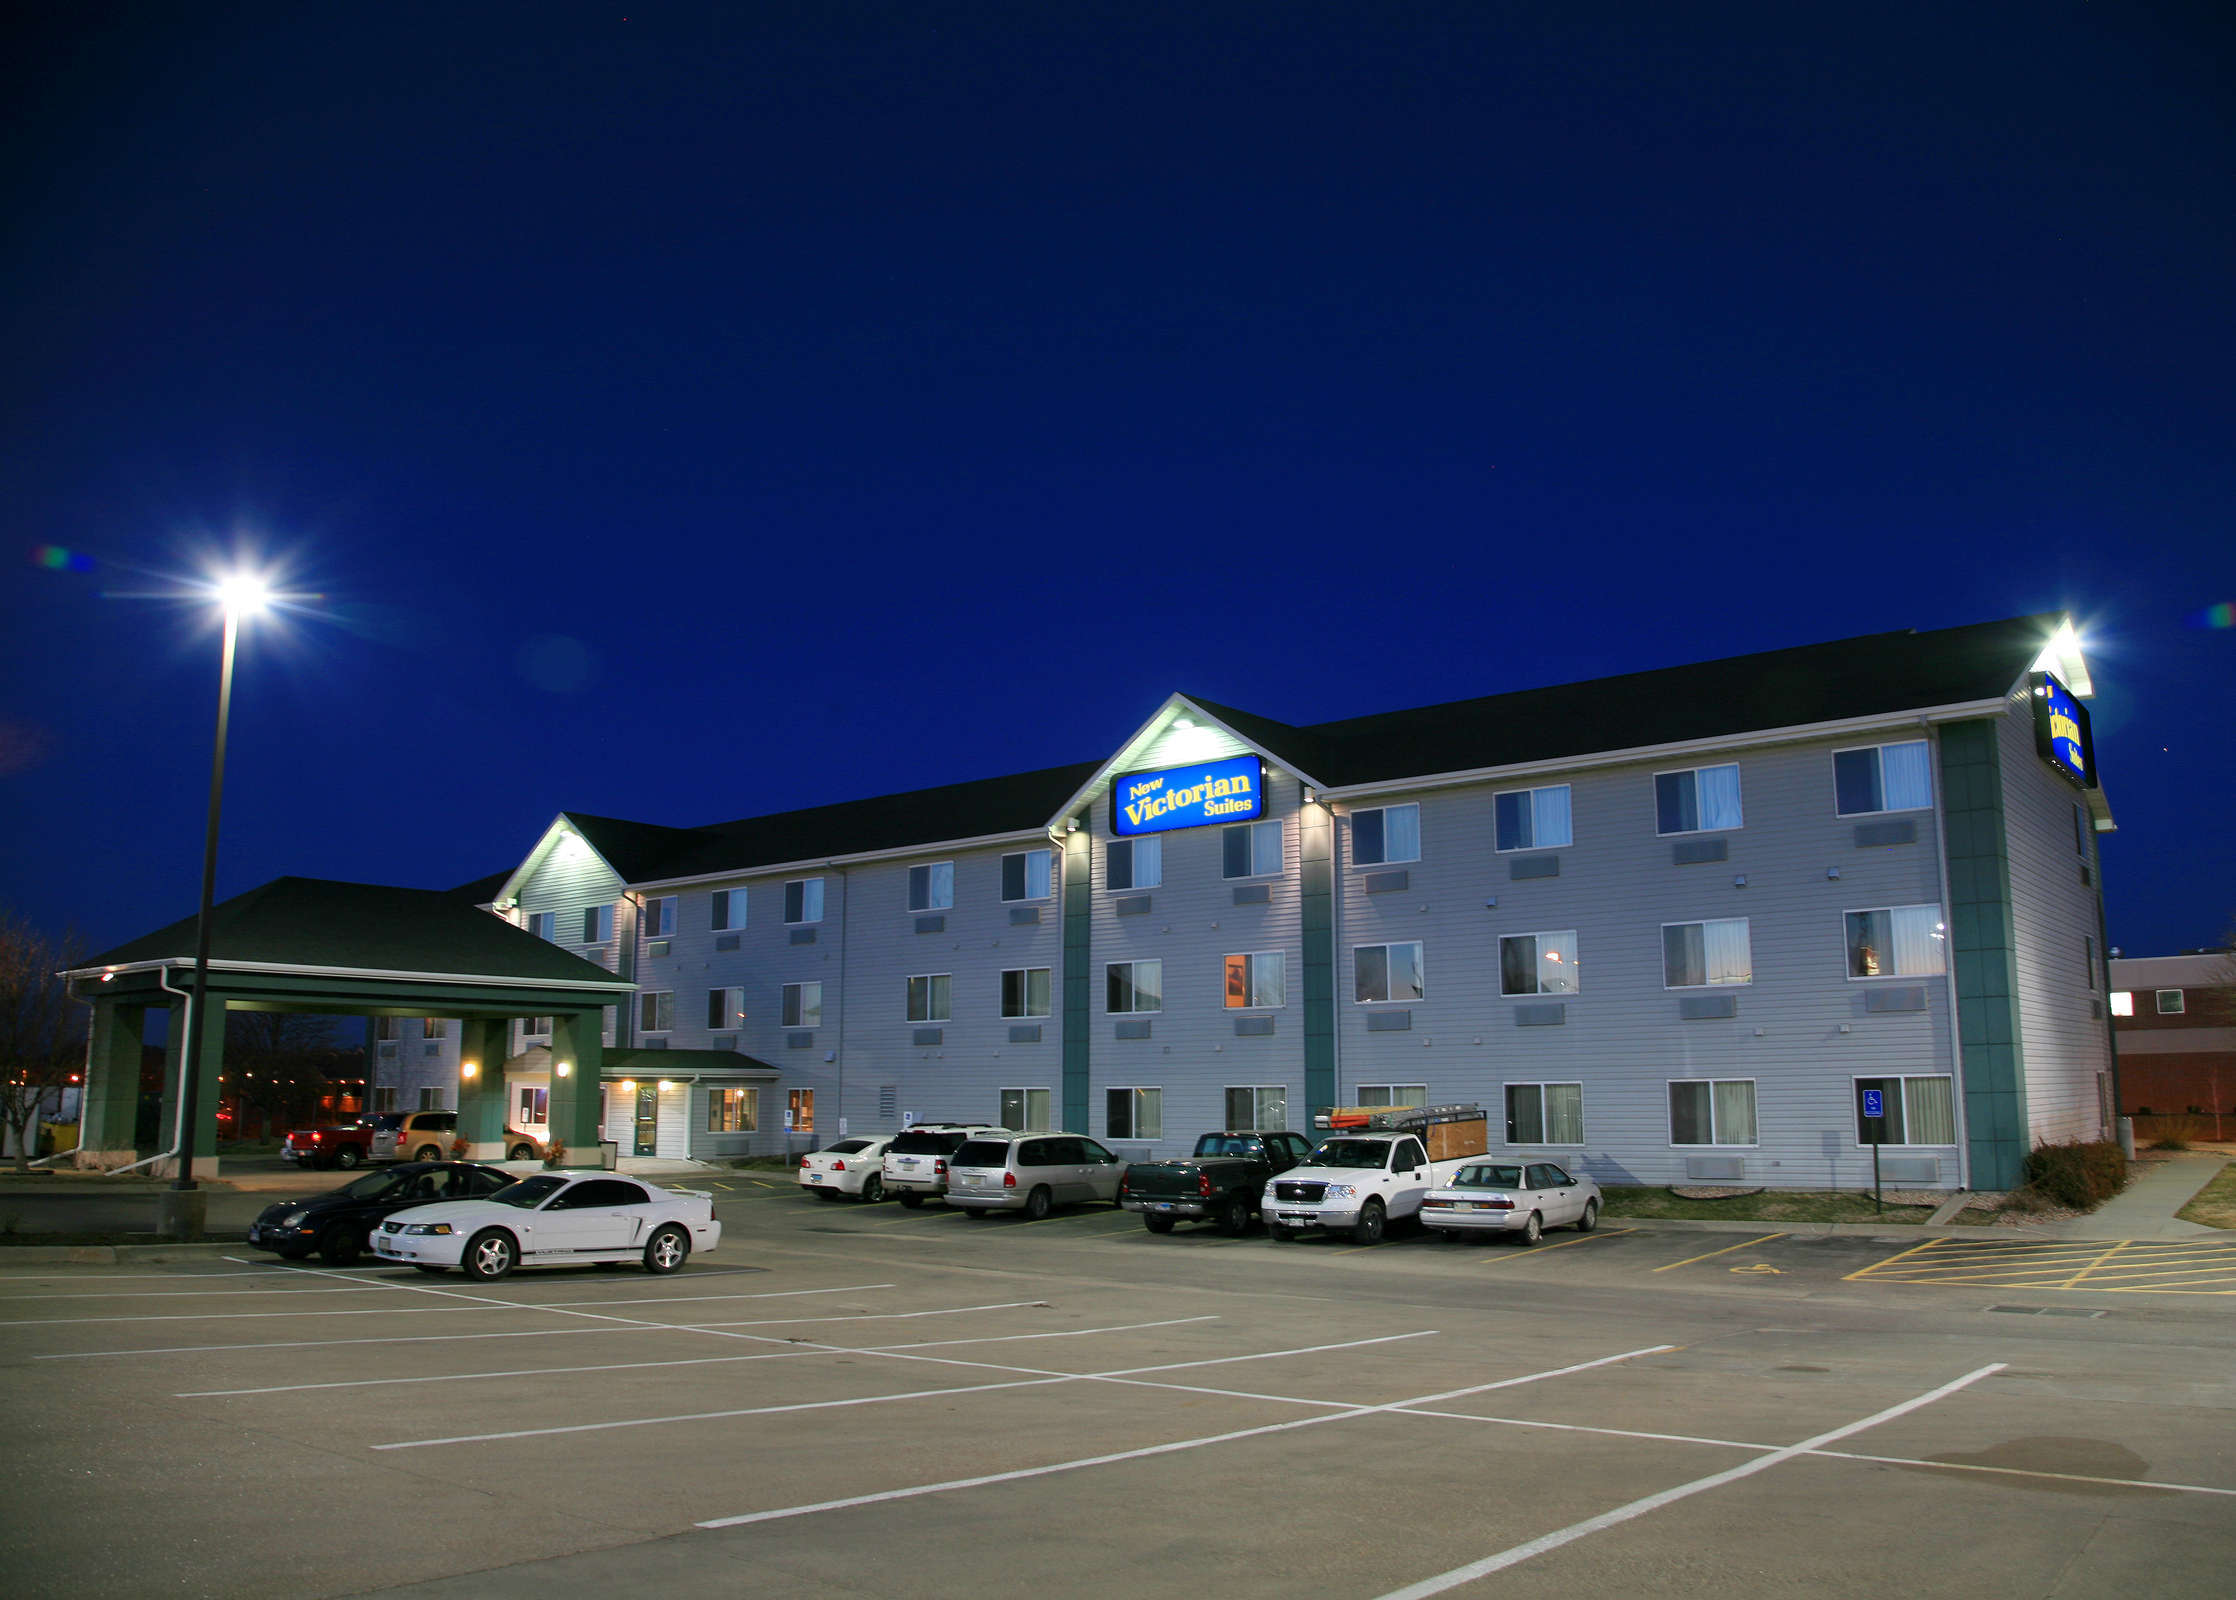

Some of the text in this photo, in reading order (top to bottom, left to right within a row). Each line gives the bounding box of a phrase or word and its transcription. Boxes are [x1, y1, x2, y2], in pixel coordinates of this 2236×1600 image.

[1130, 777, 1164, 800] New
[1124, 775, 1252, 826] Victorian
[1204, 798, 1252, 816] Suites
